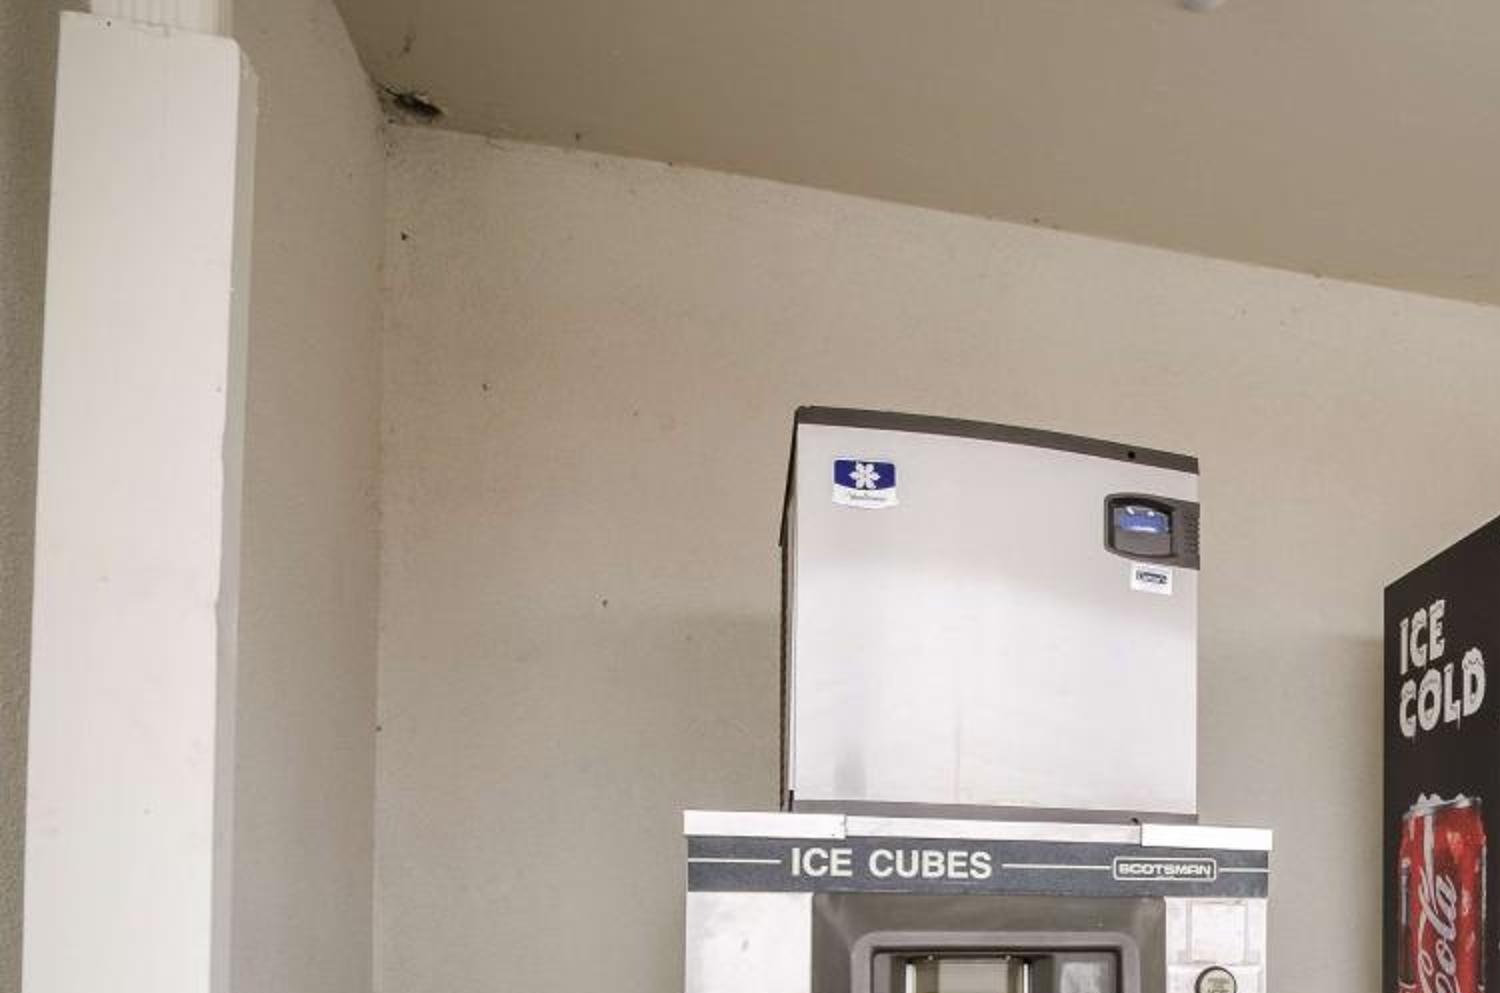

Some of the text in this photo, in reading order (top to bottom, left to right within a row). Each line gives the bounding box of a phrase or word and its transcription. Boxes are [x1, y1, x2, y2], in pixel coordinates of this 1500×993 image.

[1400, 599, 1445, 675] ICE
[1399, 647, 1486, 738] COLD
[791, 848, 993, 879] ICE CUBES
[1119, 862, 1212, 877] SCOTSMAN
